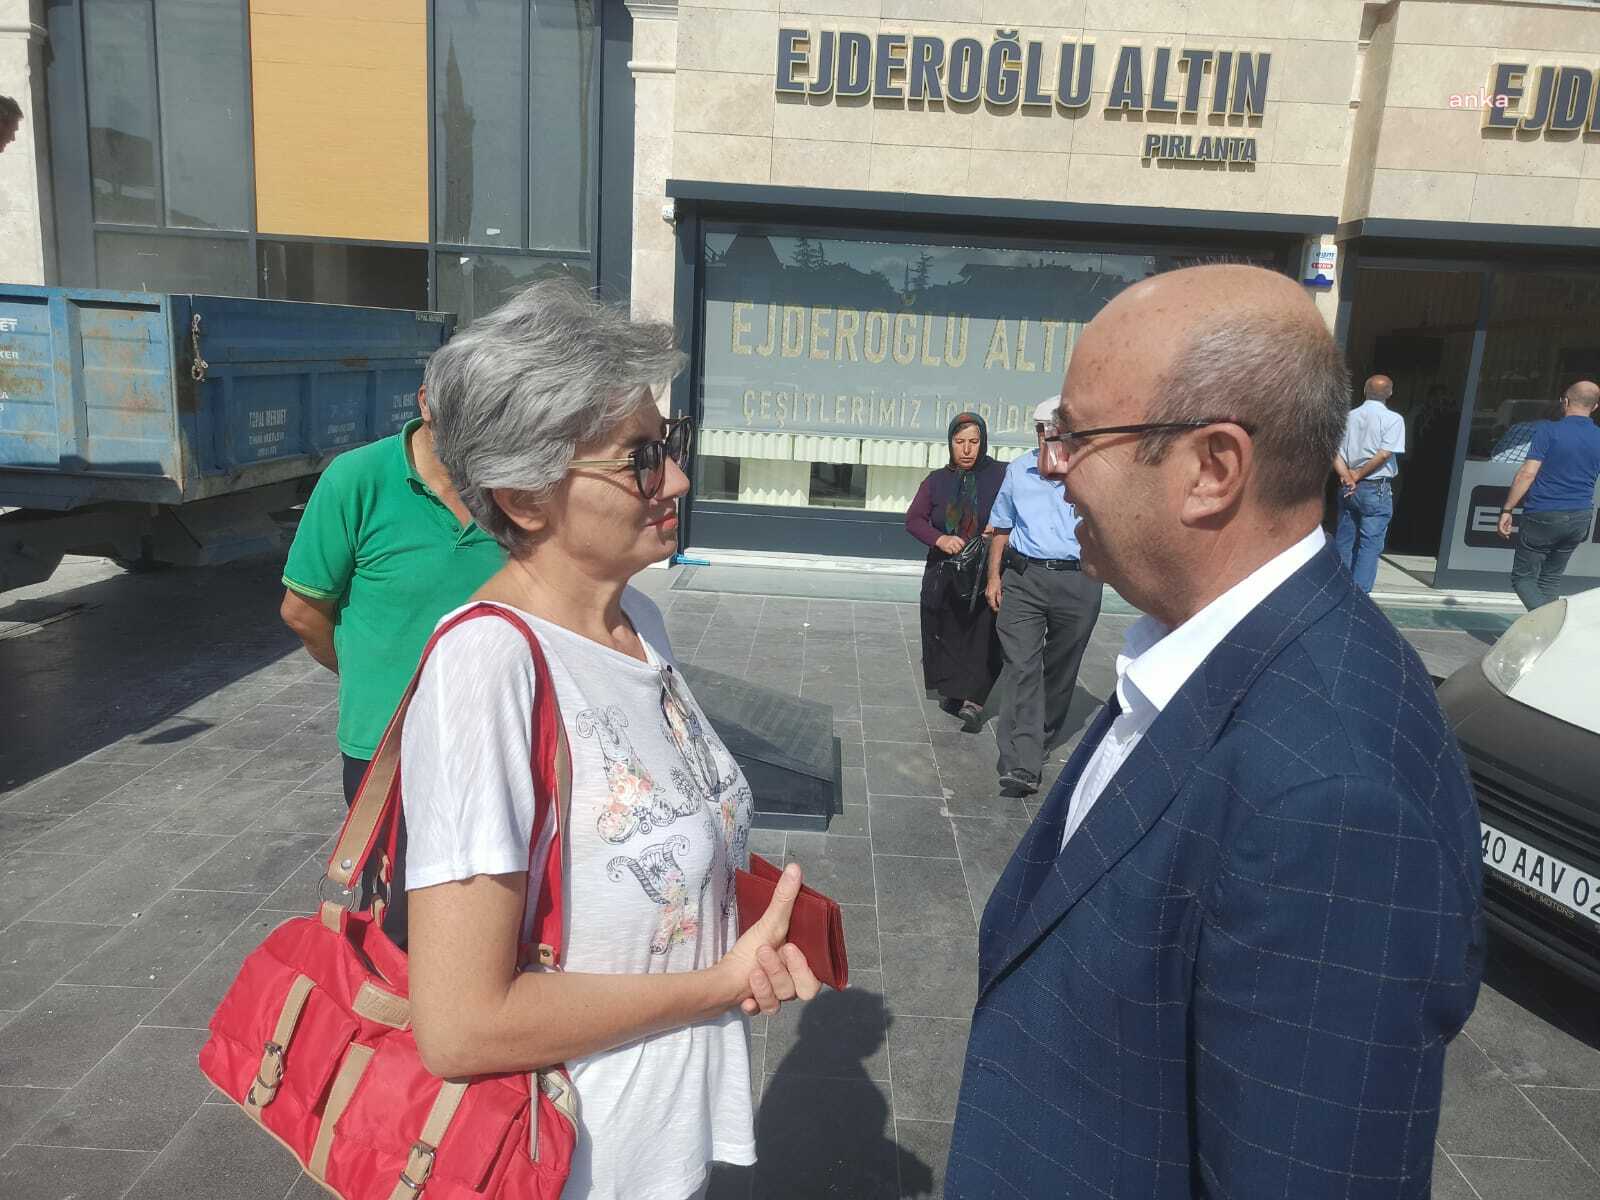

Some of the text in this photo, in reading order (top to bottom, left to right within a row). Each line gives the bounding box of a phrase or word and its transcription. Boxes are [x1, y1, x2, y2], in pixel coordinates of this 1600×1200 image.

[775, 28, 1271, 117] EJDEROĞLU ALTIN
[1142, 134, 1257, 163] PIRLANTA
[731, 295, 1086, 373] EJDEROĞLU ALTI
[742, 390, 922, 428] ÇEŞİTLERİMİZ
[1512, 847, 1567, 895] AAV
